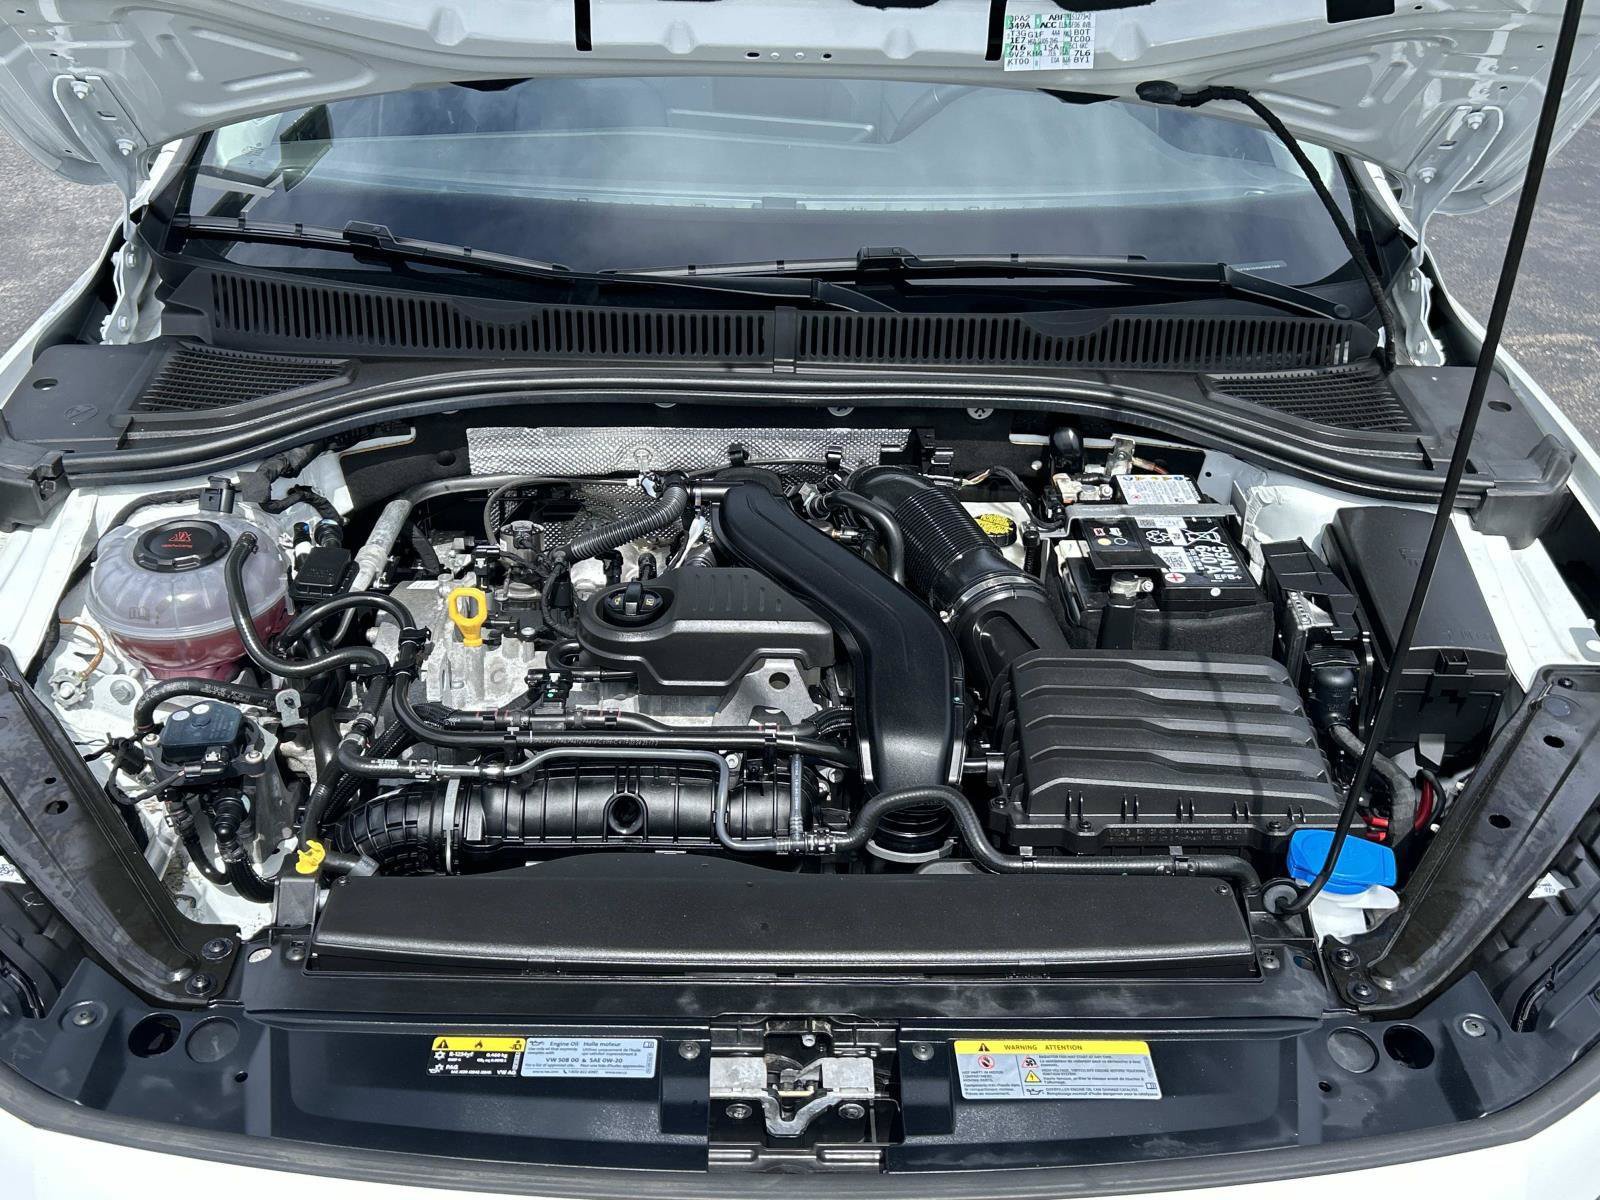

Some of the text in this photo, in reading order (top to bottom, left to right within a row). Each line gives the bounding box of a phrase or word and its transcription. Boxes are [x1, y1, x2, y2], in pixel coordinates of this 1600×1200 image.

[1194, 546, 1218, 564] 640
[1212, 546, 1239, 573] 59Ah
[1204, 564, 1223, 574] A
